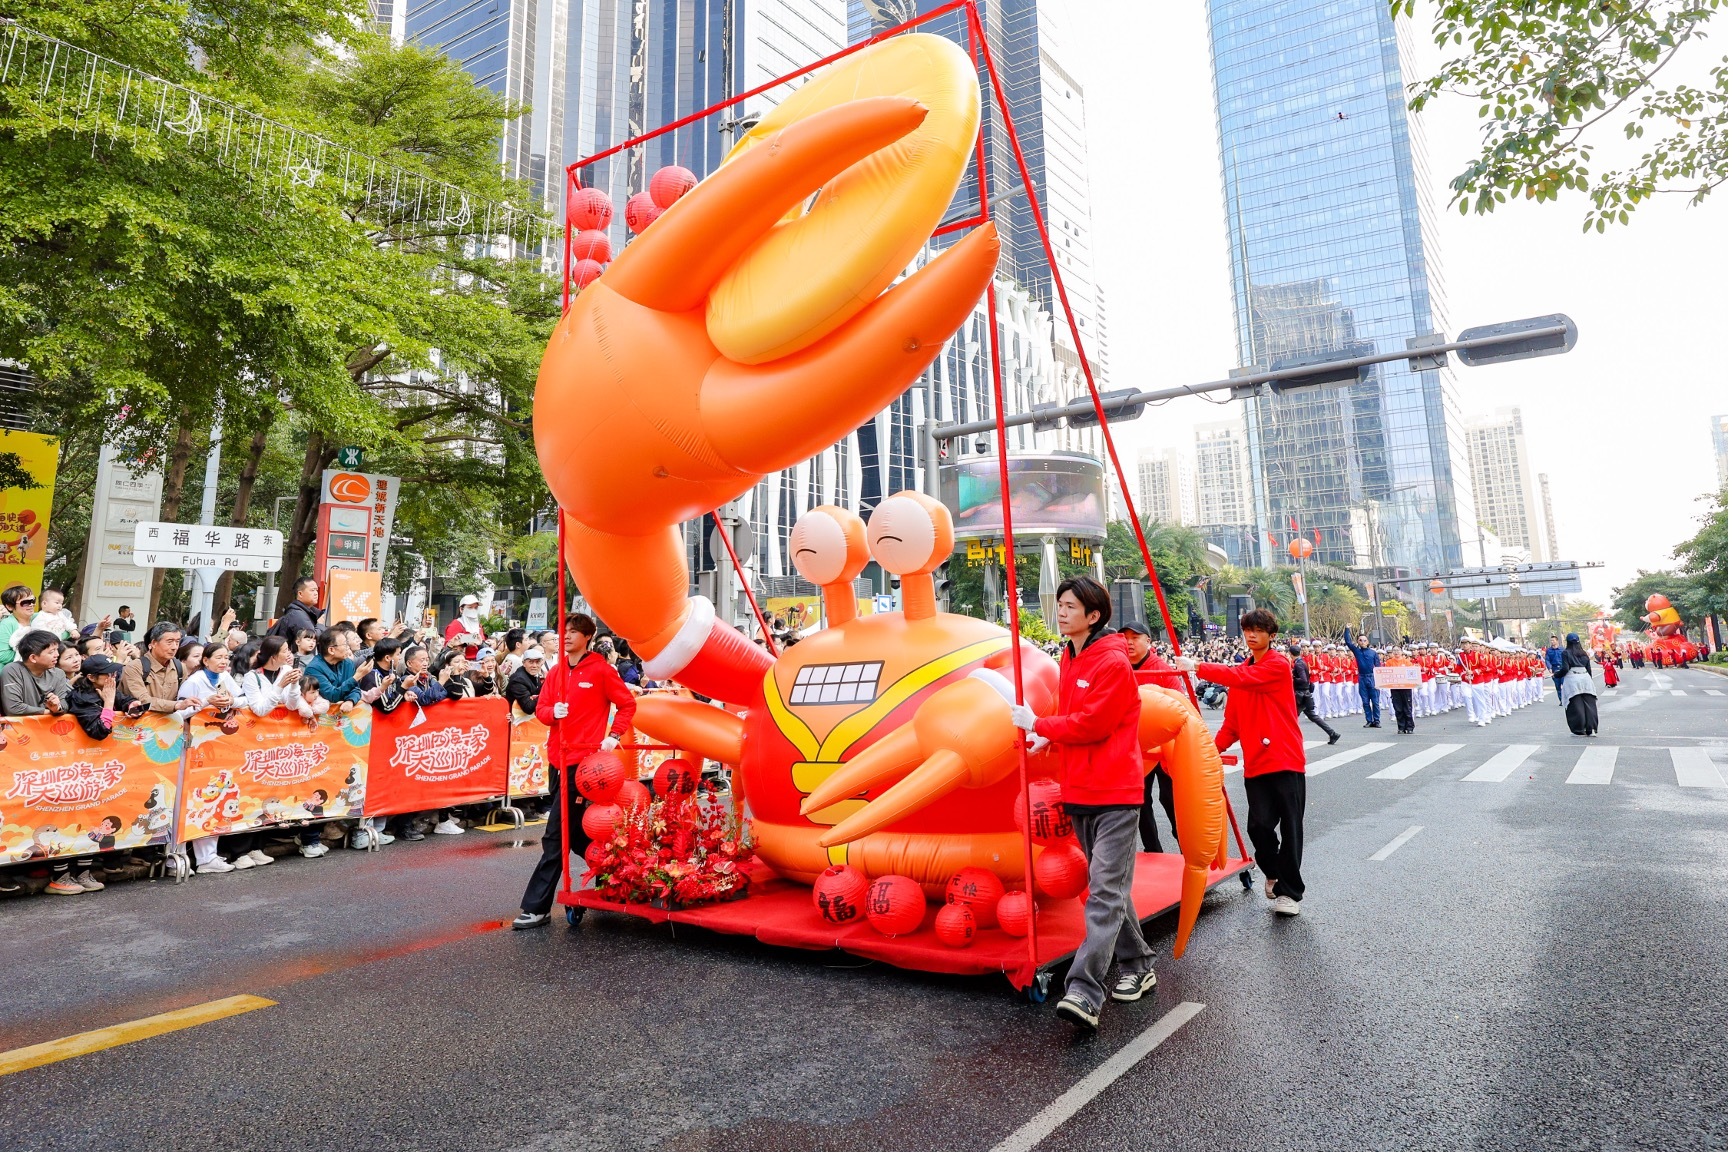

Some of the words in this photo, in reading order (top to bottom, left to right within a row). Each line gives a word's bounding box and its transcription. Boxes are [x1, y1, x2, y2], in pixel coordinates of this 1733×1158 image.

[148, 527, 159, 538] 西
[172, 529, 250, 549] 福华路
[263, 535, 273, 545] 东
[147, 554, 156, 563] W
[182, 556, 216, 566] Fuhua
[224, 558, 238, 567] Rd
[263, 560, 270, 569] E
[240, 742, 329, 774] 深圳四海一家
[390, 724, 489, 767] 深圳四海一家
[253, 760, 314, 782] 大巡游
[292, 776, 311, 785] GRAND
[312, 766, 331, 779] PARADE
[406, 750, 473, 776] 大巡游
[414, 773, 447, 782] SHENZHEN
[448, 768, 470, 780] GRAND
[470, 755, 491, 772] PARADE
[6, 759, 125, 799] 深圳四海一家
[24, 780, 105, 807] 大巡游
[35, 804, 75, 812] SHENZHEN
[76, 801, 101, 811] GRAND
[101, 788, 128, 805] PARADE
